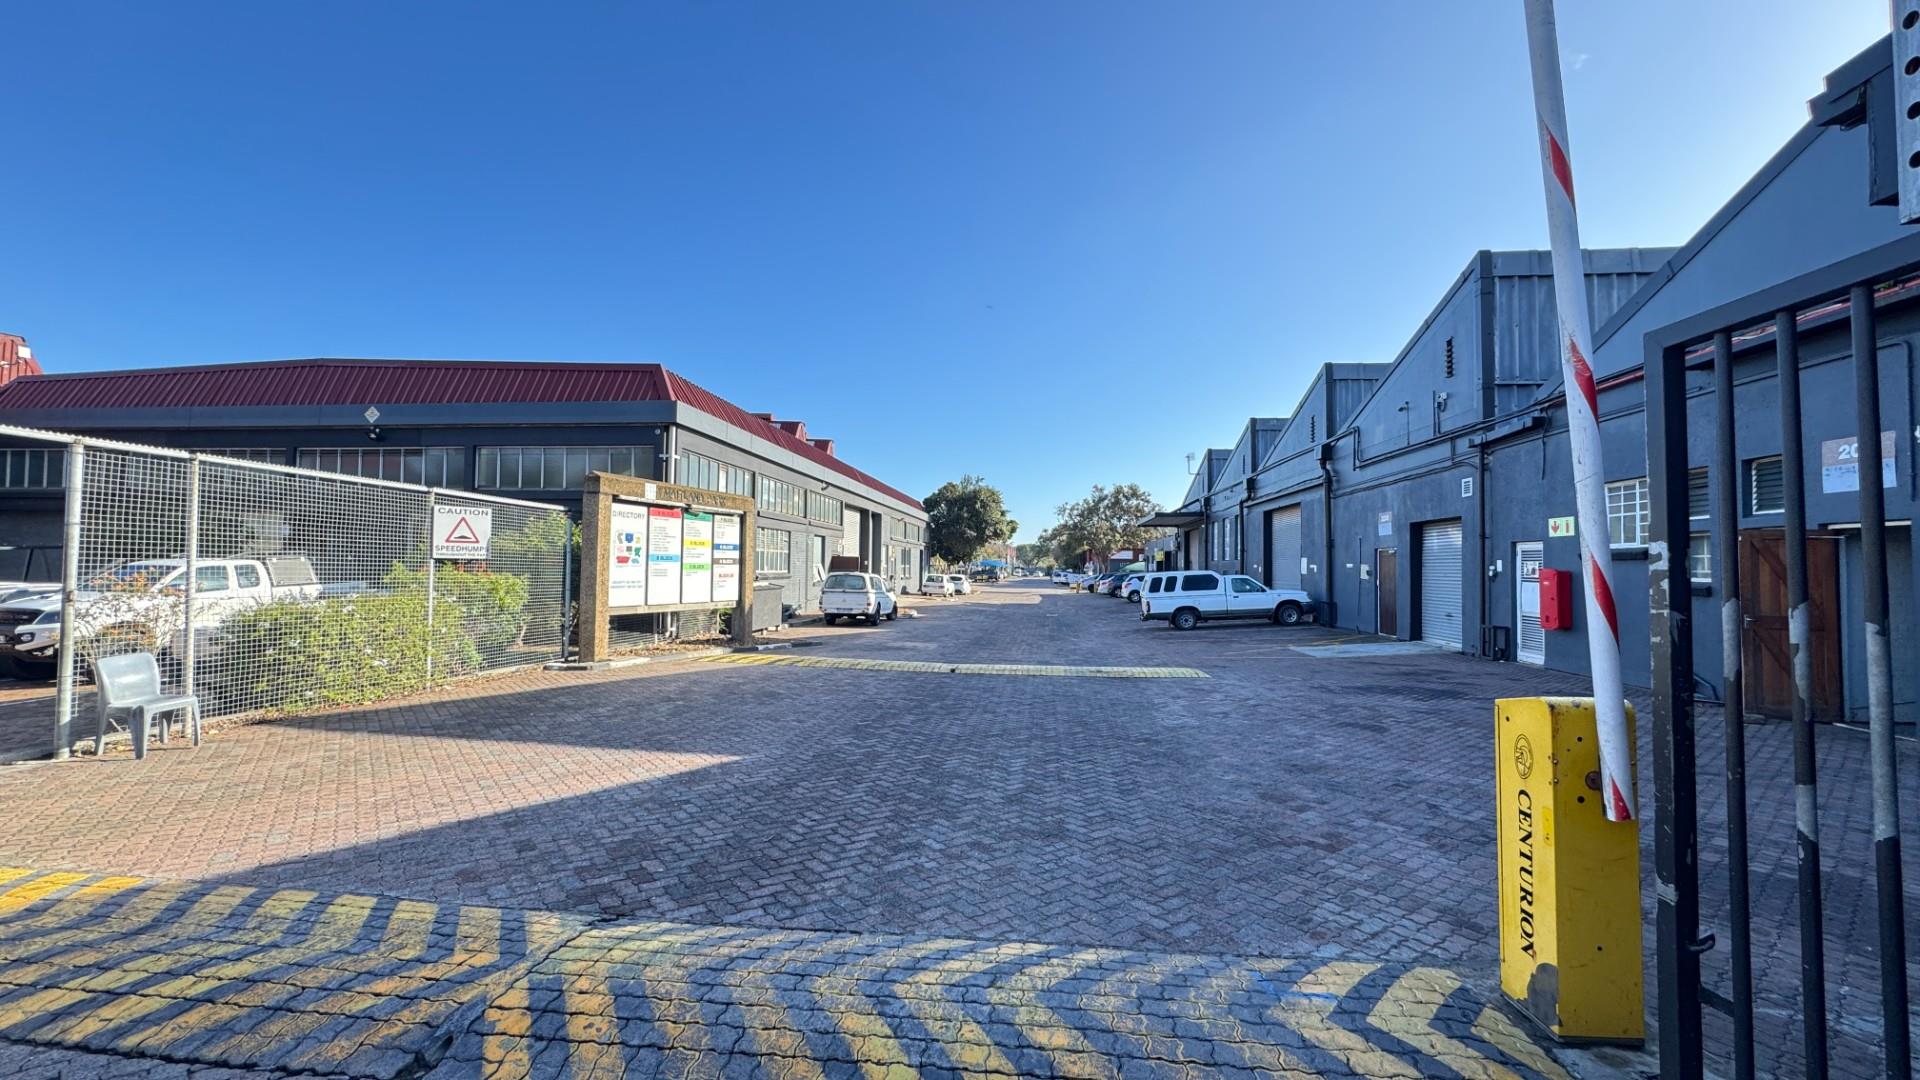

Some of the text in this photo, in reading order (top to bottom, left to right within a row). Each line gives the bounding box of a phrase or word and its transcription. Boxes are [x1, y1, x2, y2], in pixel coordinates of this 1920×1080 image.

[438, 507, 489, 516] CAUTION
[612, 510, 646, 520] DIRECTORY
[1518, 788, 1535, 961] CENTURION
